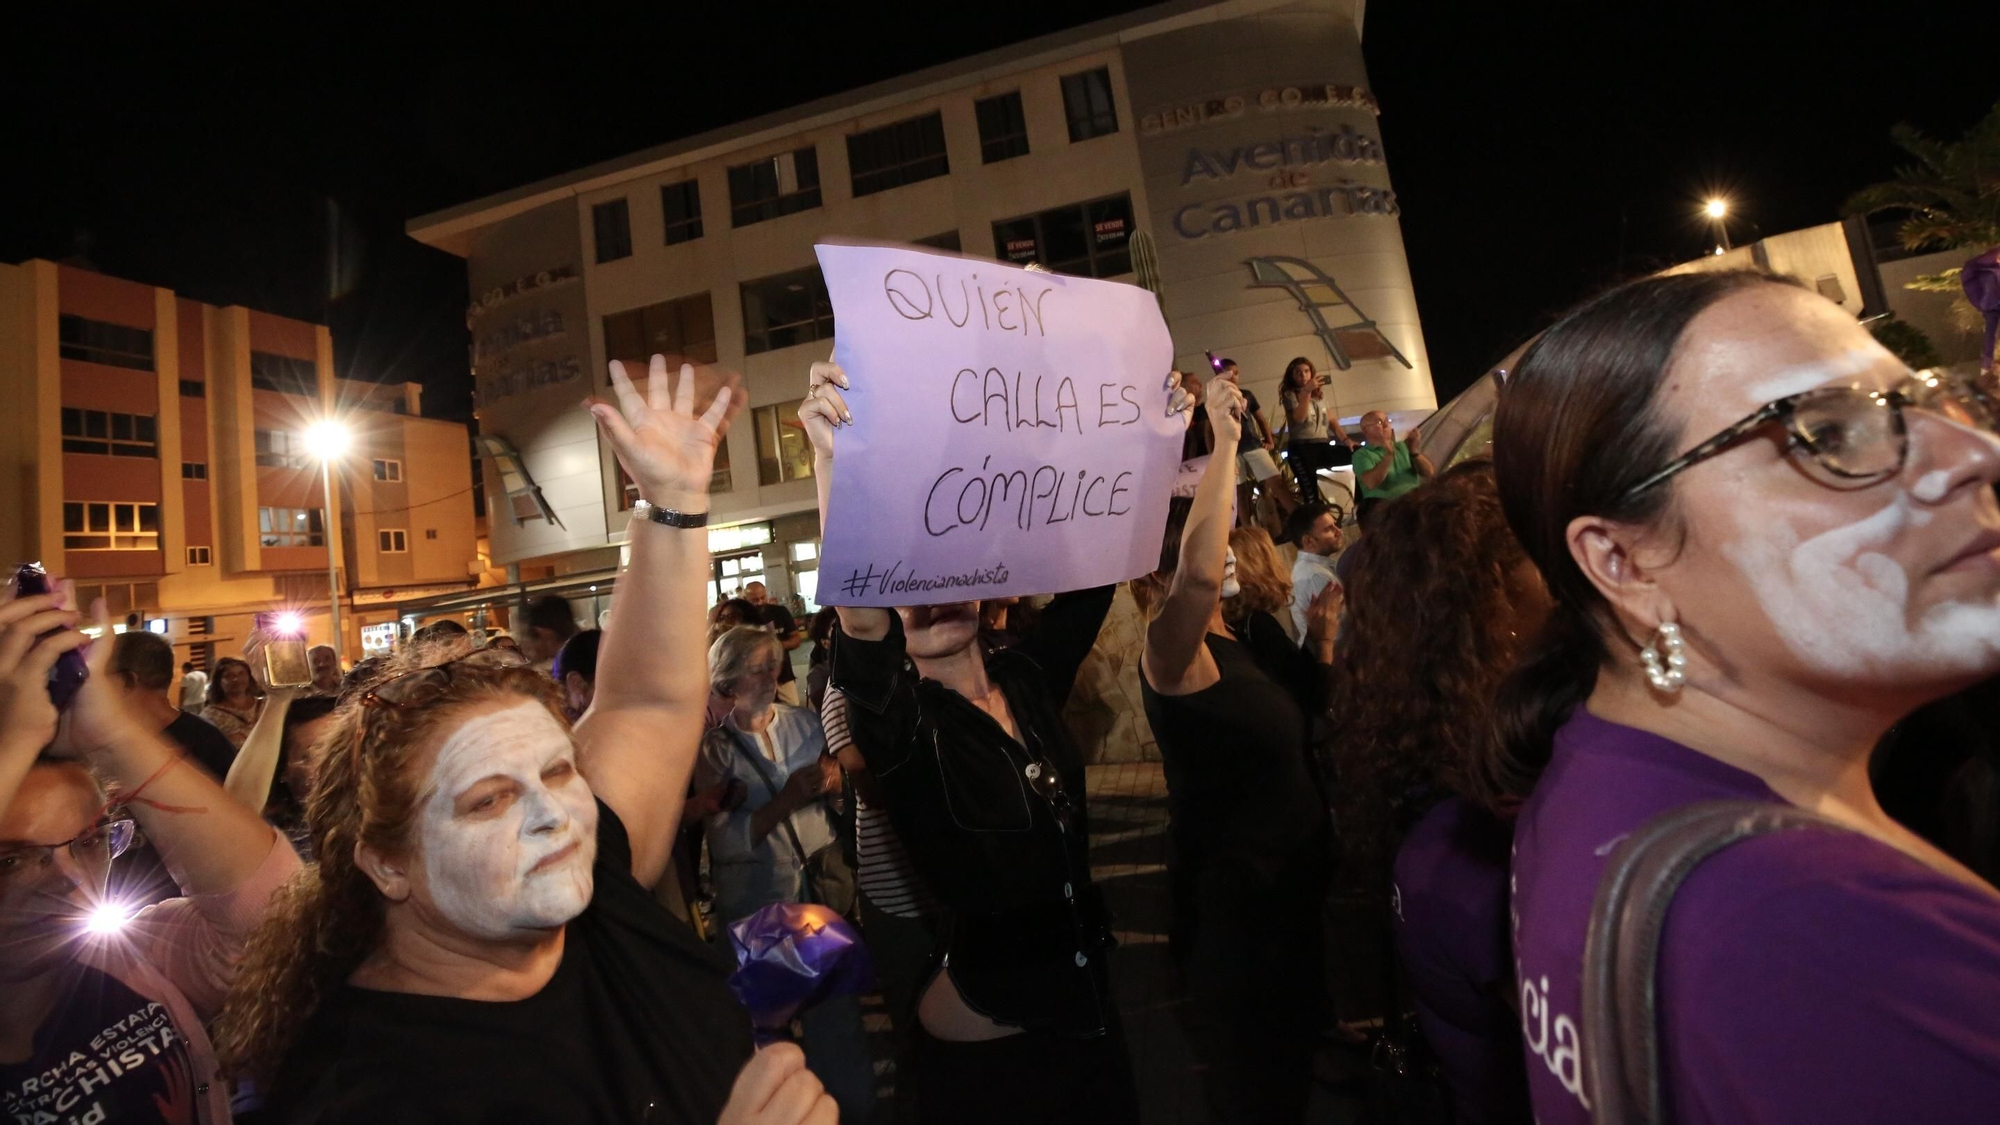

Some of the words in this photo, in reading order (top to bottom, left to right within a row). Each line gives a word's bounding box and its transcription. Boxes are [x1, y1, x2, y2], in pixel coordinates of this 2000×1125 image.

[1140, 97, 1243, 134] CENTRO
[1180, 123, 1385, 187] Avenida
[1269, 169, 1312, 190] de
[1173, 178, 1400, 240] Canarias
[950, 367, 1083, 435] CALLA
[1098, 382, 1141, 429] ES
[64, 1059, 98, 1085] LAS
[100, 1013, 168, 1060] VIOLENCI
[90, 1001, 162, 1051] ESTATA
[1521, 974, 1592, 1113] cia
[13, 1026, 176, 1125] ACHISTA
